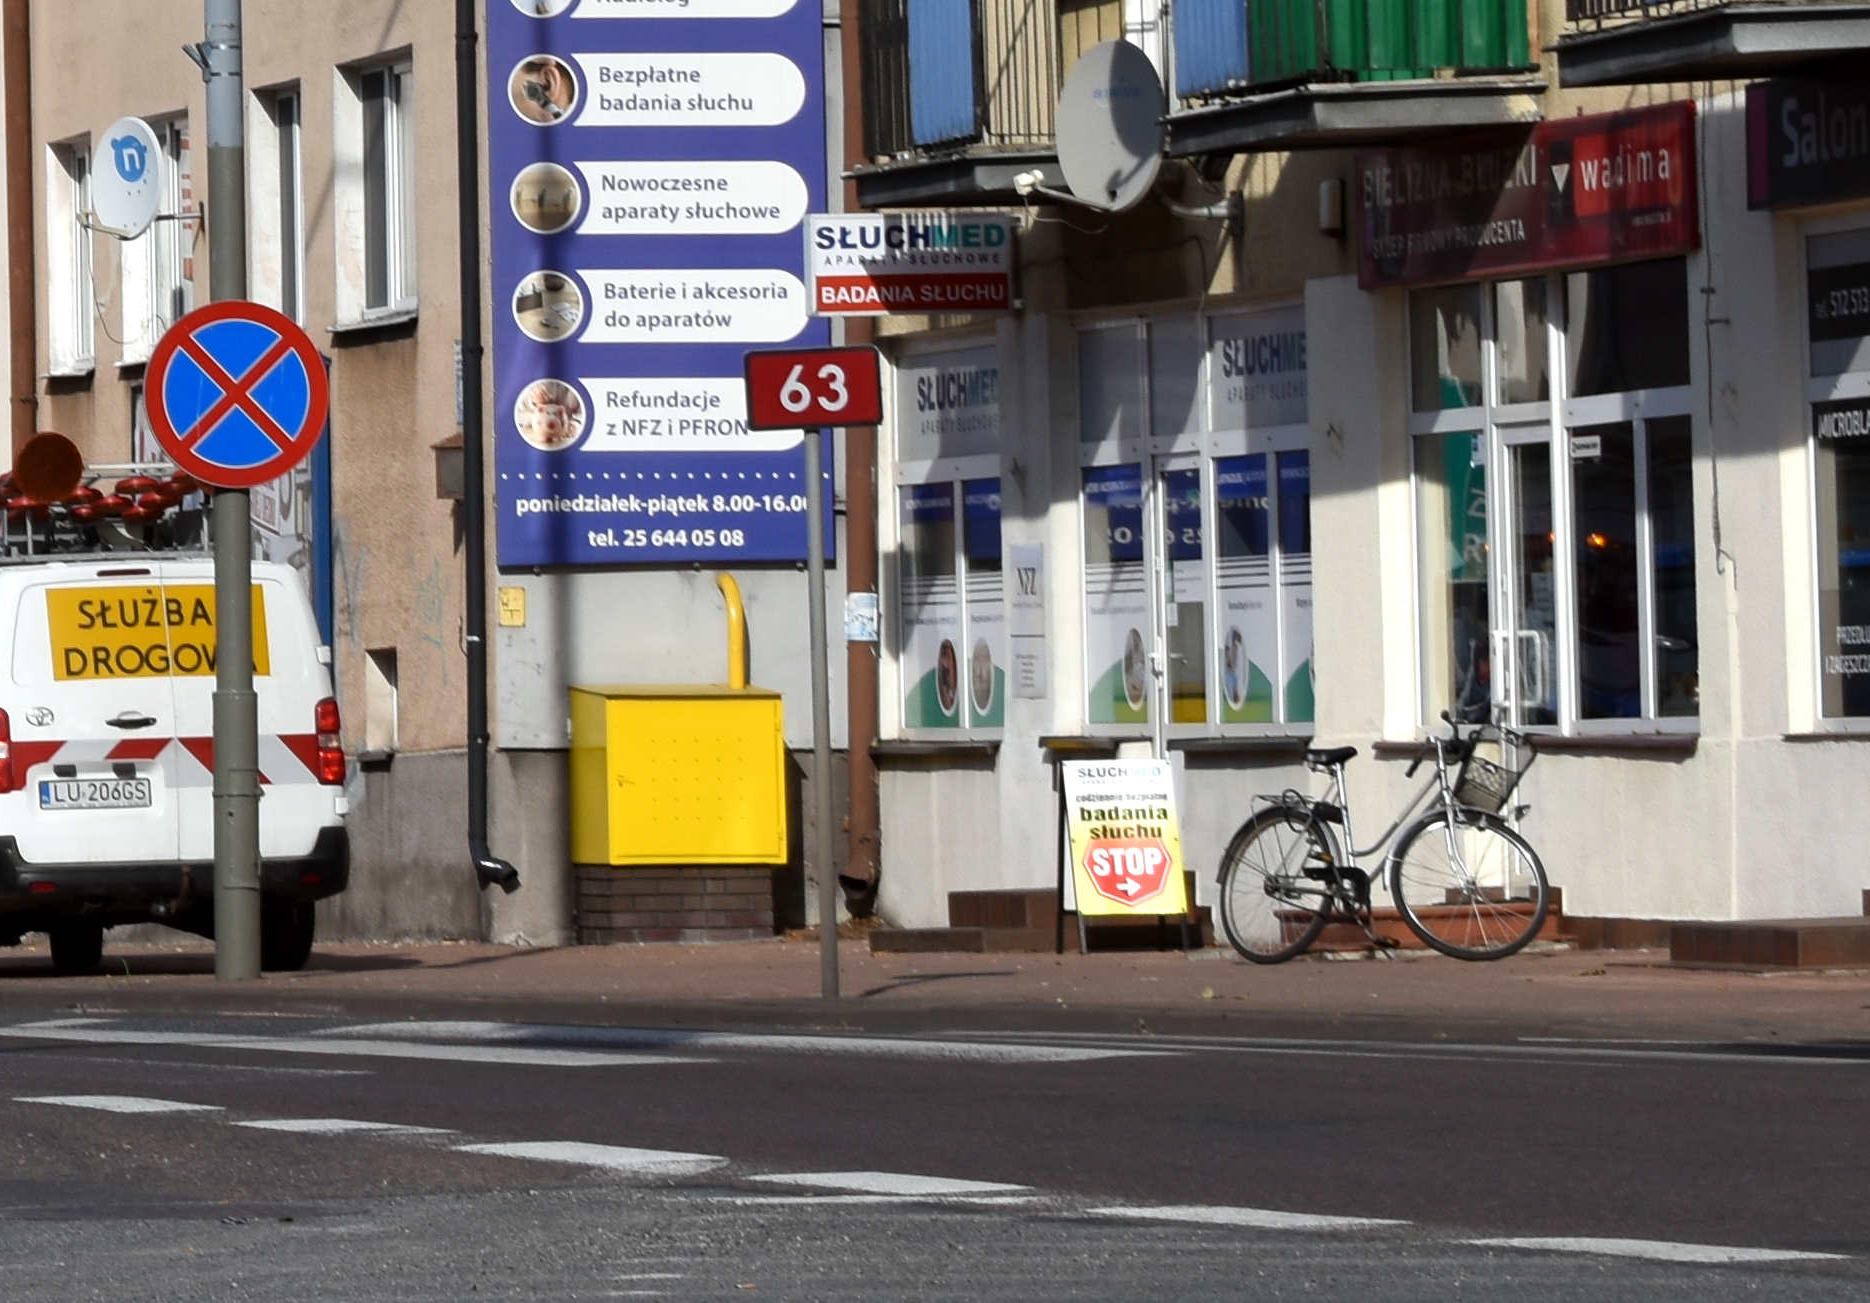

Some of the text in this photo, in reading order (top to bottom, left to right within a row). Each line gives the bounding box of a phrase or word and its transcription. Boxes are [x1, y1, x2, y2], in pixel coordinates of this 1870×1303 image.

[599, 65, 701, 87] Bezpłatne
[599, 93, 754, 111] badania słuchu
[1580, 144, 1671, 192] wadima
[601, 174, 729, 192] Nowoczesne
[602, 201, 781, 223] aparaty słuchowe
[816, 224, 1006, 250] SŁUCHMED
[824, 252, 1001, 266] APARATY SŁUCHOWE
[604, 282, 789, 300] Baterie i akcesoria
[821, 283, 1005, 305] BADANIA SŁUCHU
[604, 310, 732, 331] do aparatów
[1223, 332, 1307, 378] SŁUCHME
[779, 363, 849, 413] 63
[605, 391, 721, 413] Refundacje
[606, 418, 749, 436] z NFZ i PFRON
[516, 493, 710, 517] poniedziałek-piątek
[588, 529, 745, 547] tel. 25 644 05 08
[78, 588, 213, 630] SŁUŻBA
[54, 781, 146, 802] LU 206GS
[1080, 805, 1168, 821] badania
[1090, 824, 1162, 839] słuchu
[1092, 847, 1162, 876] STOP
